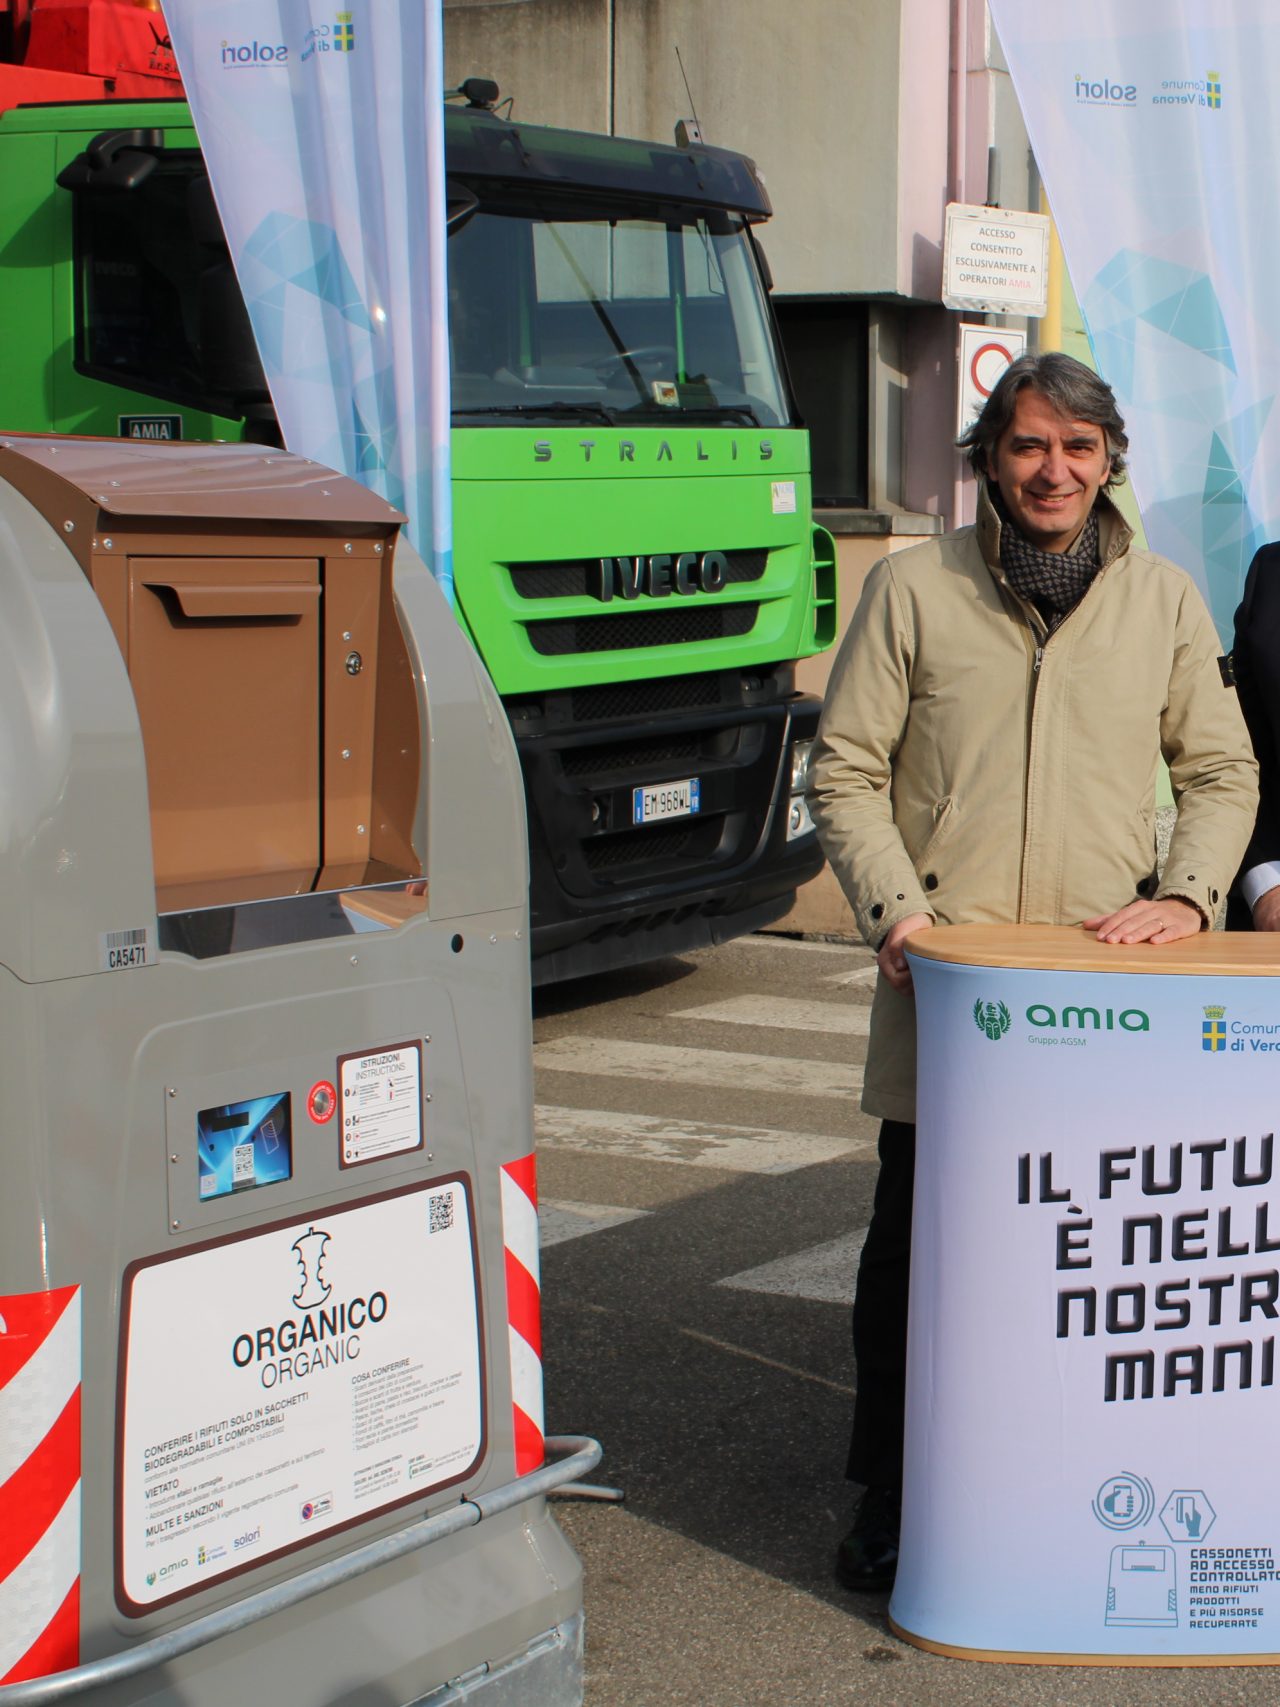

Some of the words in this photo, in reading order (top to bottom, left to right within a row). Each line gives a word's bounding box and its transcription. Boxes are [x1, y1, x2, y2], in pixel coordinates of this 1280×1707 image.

[979, 228, 1015, 240] ACCESSO
[970, 242, 1023, 256] CONSENTITO
[955, 257, 1029, 273] ESCLUSIVAMENTE
[1030, 265, 1036, 274] A
[959, 273, 1007, 286] OPERATORI
[1008, 279, 1031, 289] AMIA
[132, 424, 169, 439] AMIA
[534, 440, 773, 462] STRALIS
[600, 551, 727, 602] IVECO
[110, 947, 145, 968] CA5471
[1026, 1004, 1150, 1031] amia
[1028, 1035, 1059, 1047] Gruppo
[1061, 1036, 1087, 1047] AGSM
[1231, 1038, 1245, 1052] di
[361, 1054, 400, 1068] ISTRUZIONI
[356, 1062, 406, 1080] INSTRUCTIONS
[1018, 1151, 1071, 1205] IL
[1056, 1202, 1093, 1271] È
[233, 1291, 388, 1368] ORGANICO
[262, 1335, 360, 1388] ORGANIC
[352, 1372, 370, 1384] COSA
[372, 1358, 410, 1380] CONFERIRE
[1104, 1336, 1275, 1402] MANI
[144, 1433, 192, 1459] CONFERIRE
[200, 1420, 228, 1438] RIFIUTI
[230, 1412, 253, 1428] SOLO
[254, 1408, 263, 1419] IN
[265, 1392, 309, 1415] SACCHETTI
[145, 1439, 216, 1472] BIODEGRADABILI
[217, 1435, 223, 1445] E
[225, 1413, 285, 1443] COMPOSTABILI
[145, 1479, 179, 1499] VIETATO
[146, 1519, 174, 1538] MULTE
[177, 1515, 182, 1525] E
[184, 1500, 224, 1523] SANZIONI
[234, 1526, 261, 1548] solori
[1190, 1548, 1272, 1559] CASSONETTI
[159, 1558, 189, 1577] amia
[1190, 1560, 1210, 1570] AD
[1214, 1559, 1275, 1570] ACCESSO
[1190, 1585, 1219, 1594] MENO
[1222, 1585, 1259, 1593] RIFIUTI
[1190, 1597, 1240, 1605] PRODOTTI
[1190, 1609, 1196, 1617] E
[1199, 1606, 1216, 1617] PIÙ
[1219, 1608, 1264, 1617] RISORSE
[1190, 1619, 1258, 1628] RECUPERATE
